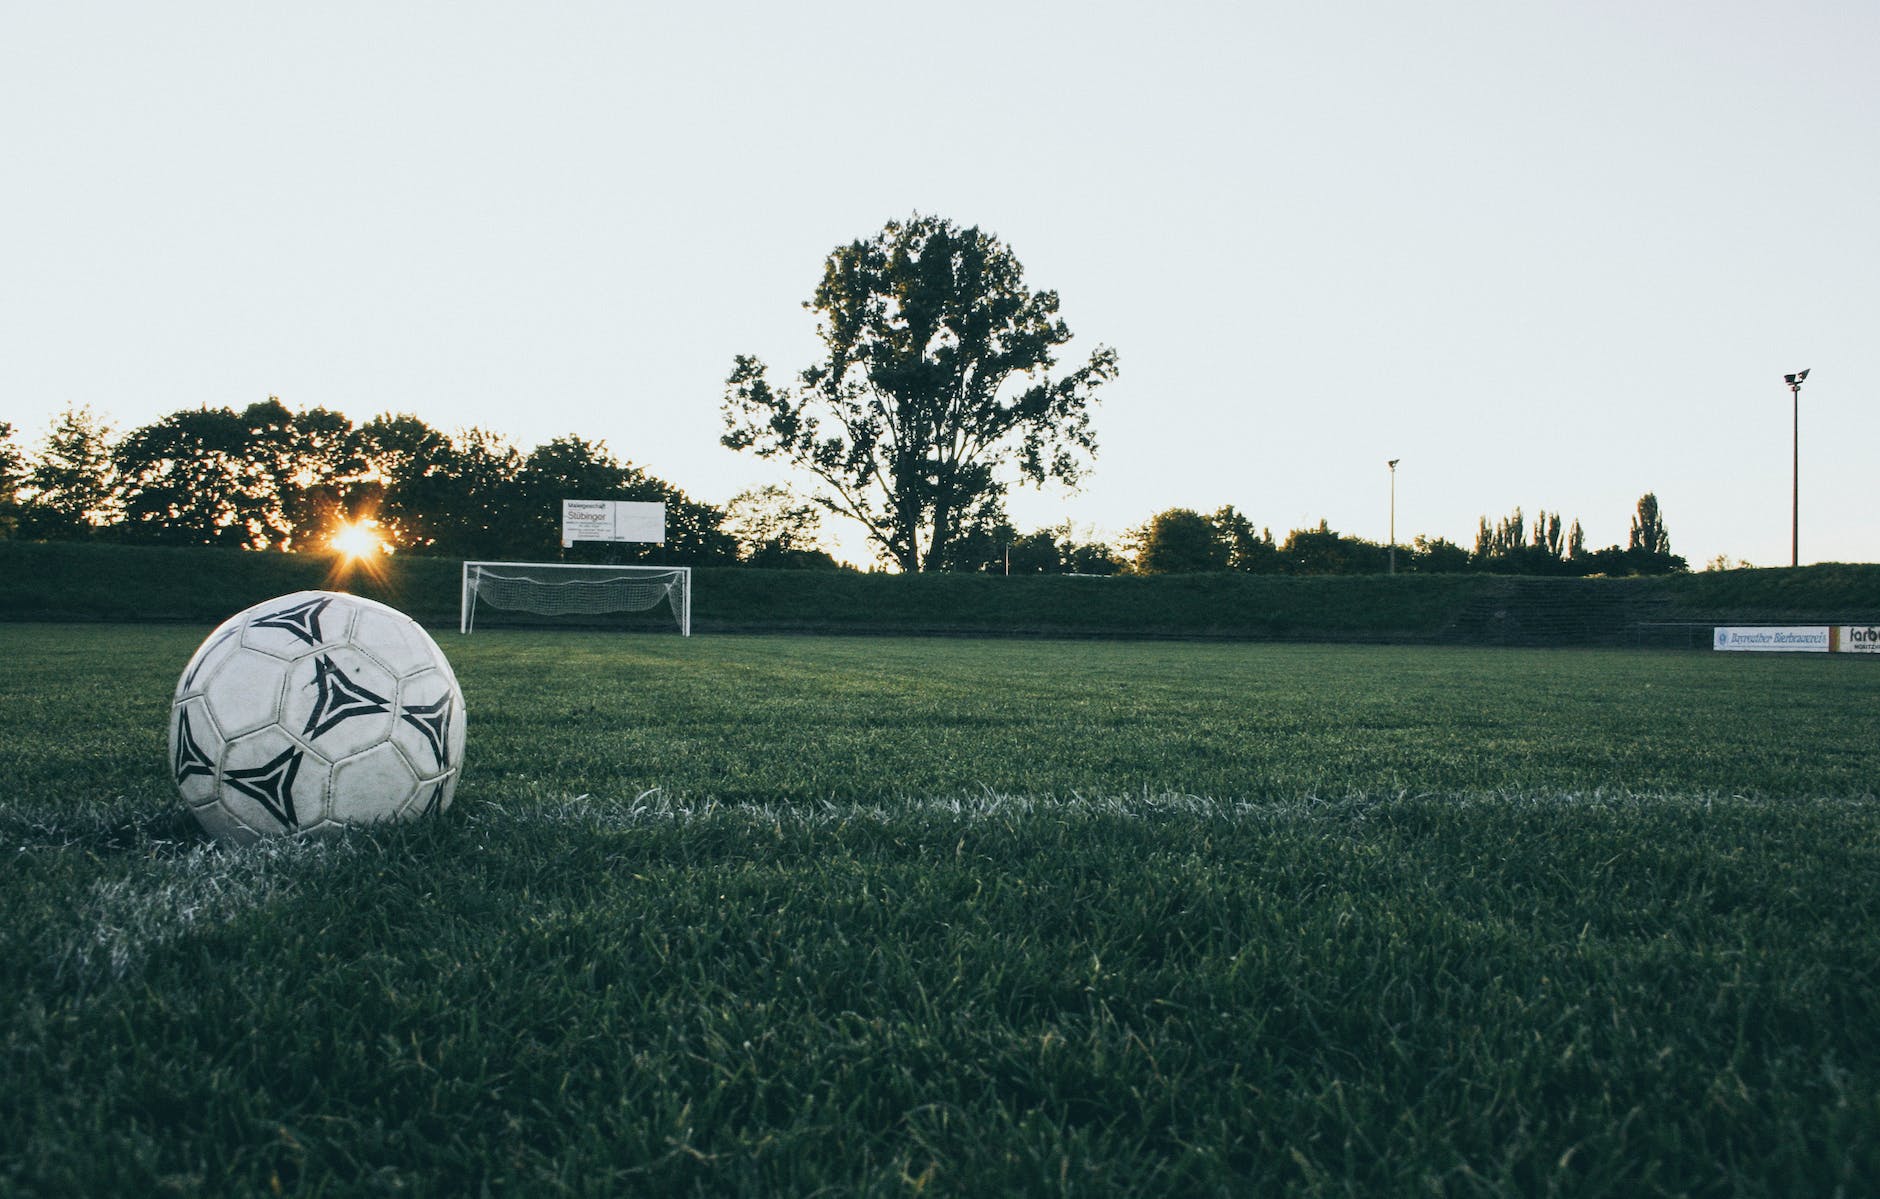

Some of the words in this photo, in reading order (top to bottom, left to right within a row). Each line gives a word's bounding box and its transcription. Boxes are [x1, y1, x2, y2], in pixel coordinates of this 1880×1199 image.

[568, 511, 606, 522] Stübinger
[1731, 633, 1773, 645] Bayreuther
[1774, 632, 1823, 644] Bierbrauerei
[1850, 627, 1880, 643] farb
